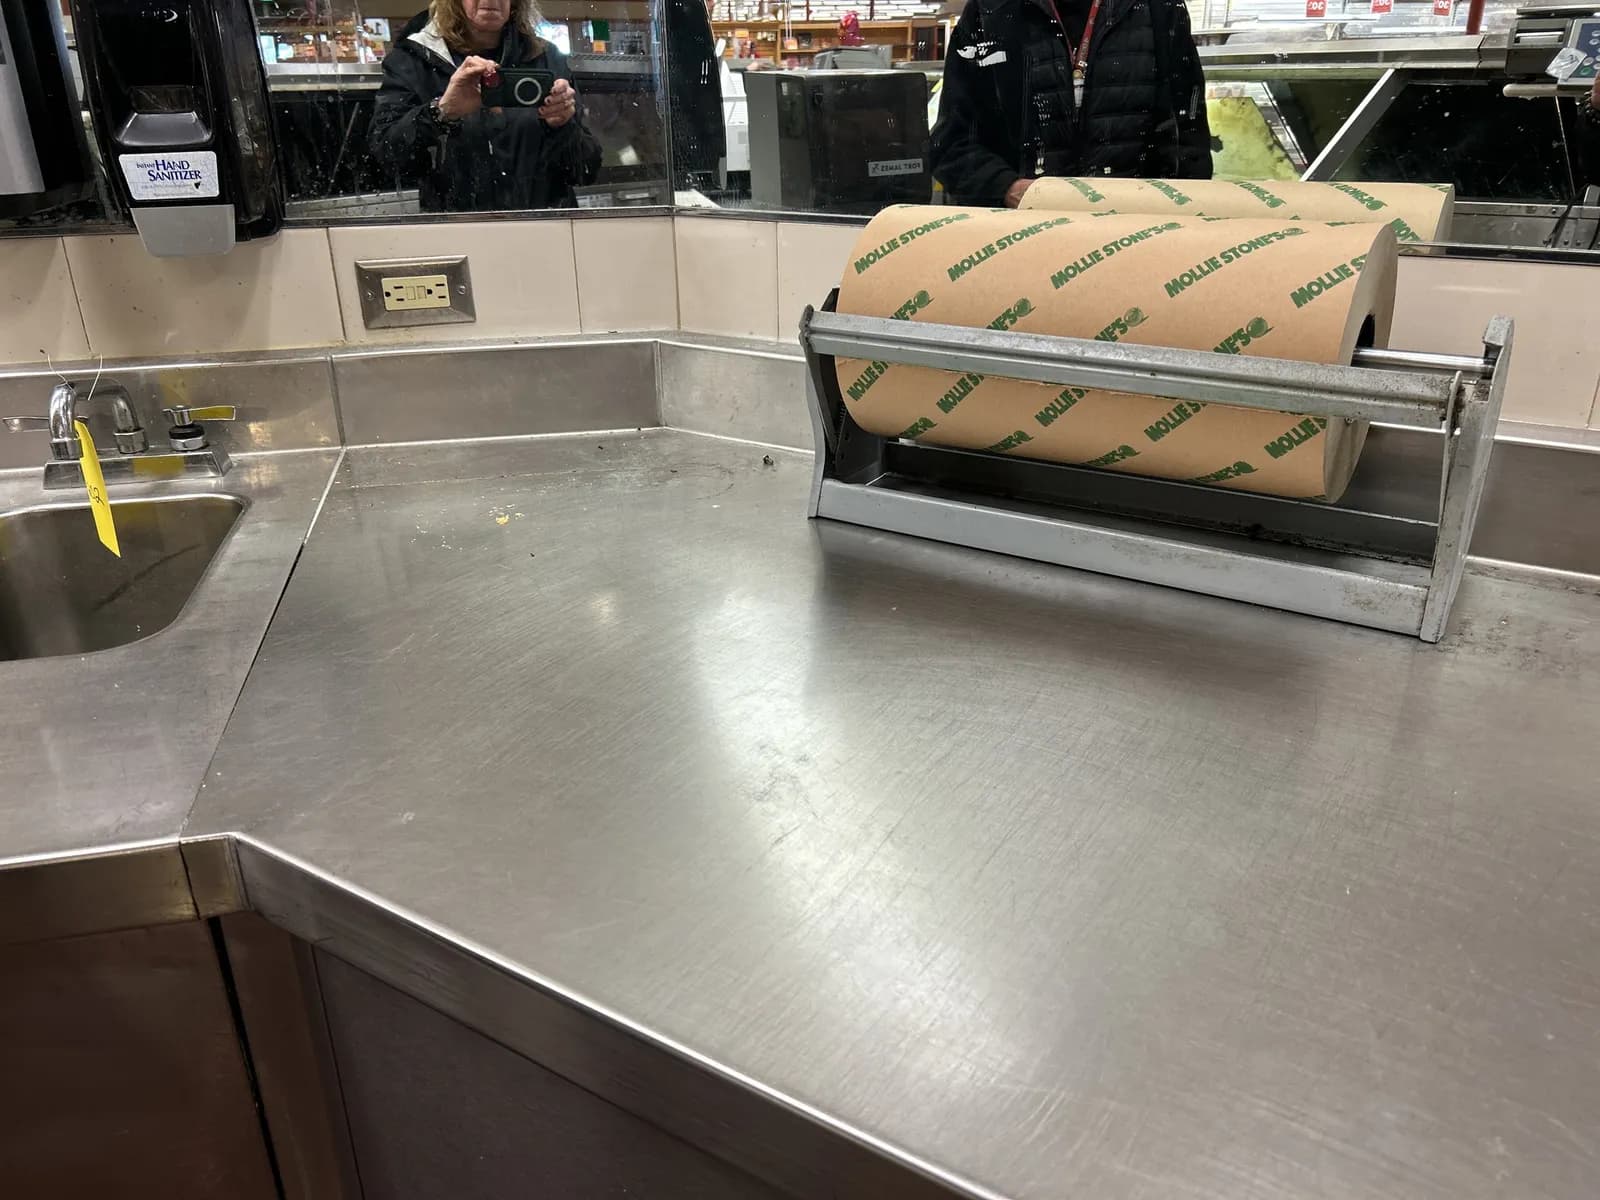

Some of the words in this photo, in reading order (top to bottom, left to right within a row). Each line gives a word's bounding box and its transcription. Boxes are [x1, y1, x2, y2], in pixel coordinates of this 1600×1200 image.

[147, 169, 202, 182] SANITIZER
[155, 159, 190, 171] HAND
[854, 237, 900, 275] MOLLIE
[898, 214, 954, 245] STONE'S
[947, 243, 998, 282] MOLLIE
[995, 220, 1053, 251] STONE'S
[1050, 249, 1104, 290] MOLLIE
[1102, 225, 1163, 257] STONE'S
[1164, 255, 1223, 298] MOLLIE
[1219, 231, 1286, 264] STONE'S
[1290, 263, 1355, 309] MOLLIE
[847, 365, 880, 402] MOLLIE
[936, 376, 974, 414] MOLLIE
[1034, 388, 1078, 427] MOLLIE
[1143, 402, 1193, 442] MOLLIE
[1263, 417, 1321, 459] MOLLIE
